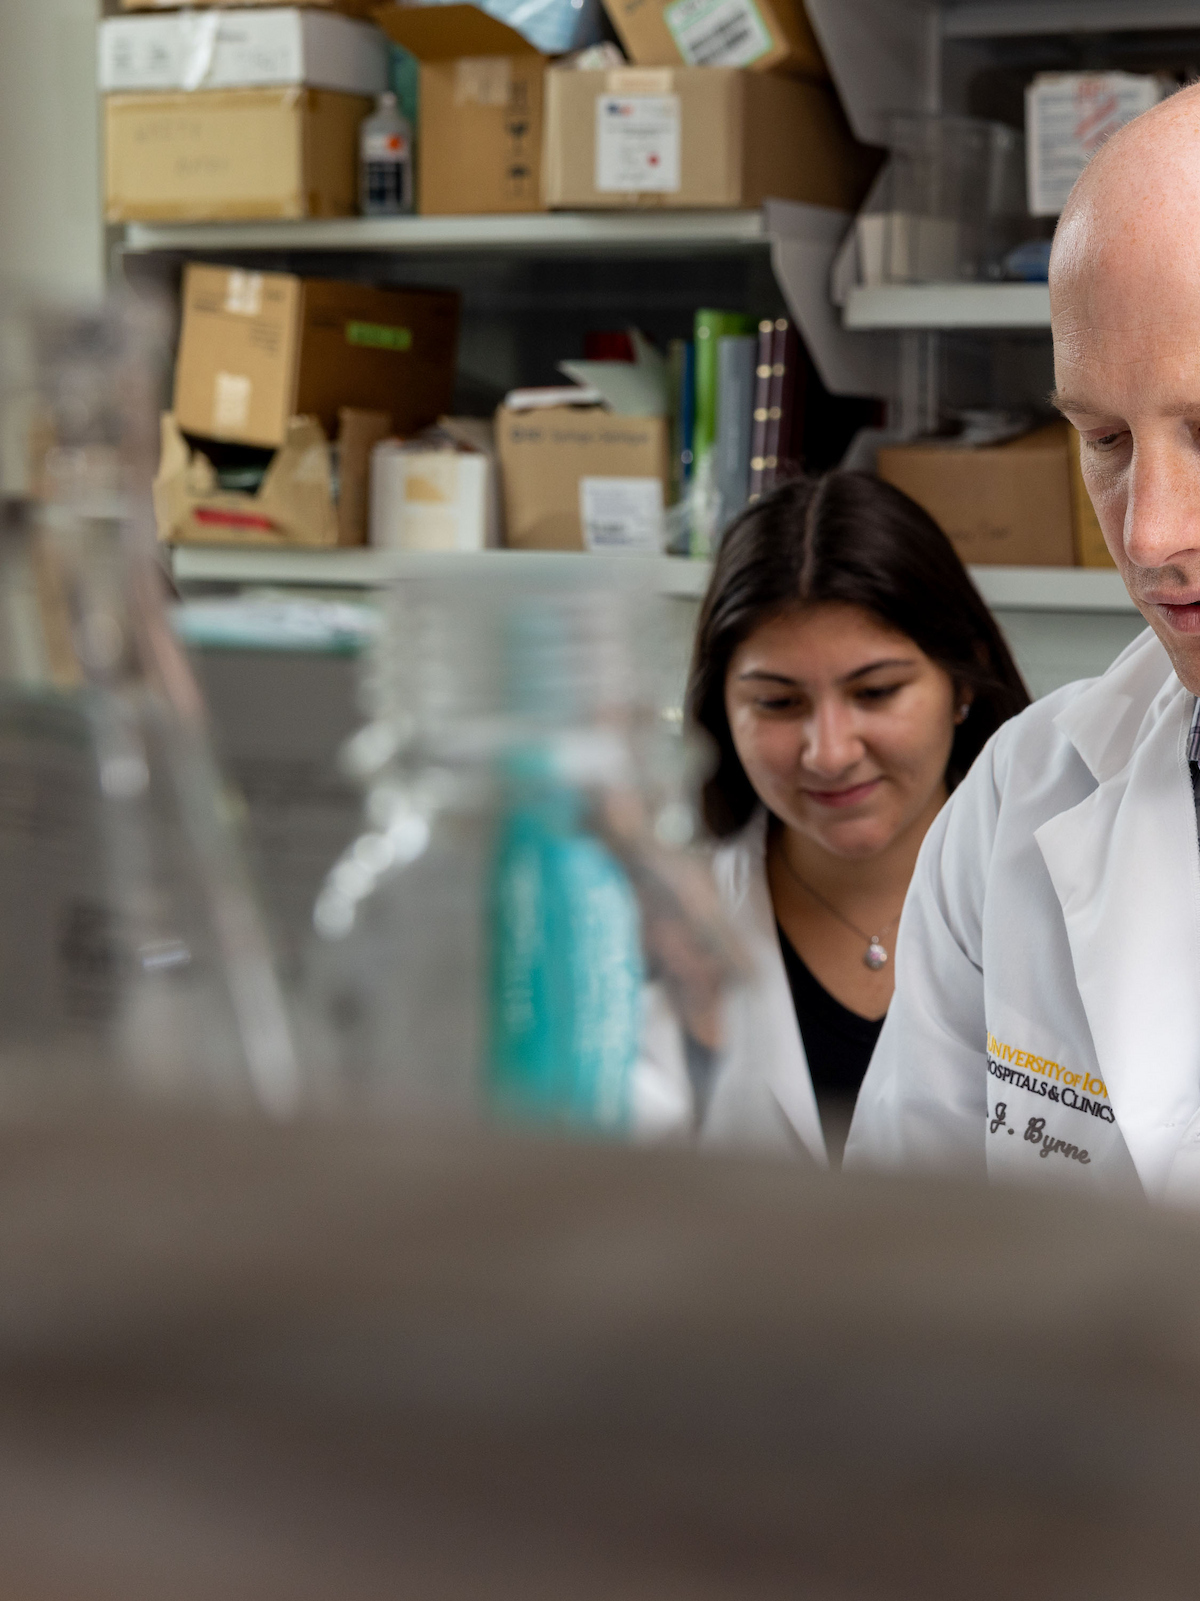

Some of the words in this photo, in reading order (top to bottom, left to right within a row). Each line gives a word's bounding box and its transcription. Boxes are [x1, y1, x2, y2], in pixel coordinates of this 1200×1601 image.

[986, 1031, 1066, 1081] UNIVERSITY
[1063, 1071, 1083, 1087] OF
[1048, 1085, 1060, 1102] &
[1061, 1087, 1116, 1123] CLINICS
[990, 1102, 1014, 1135] J.
[1024, 1117, 1091, 1164] Byrne
